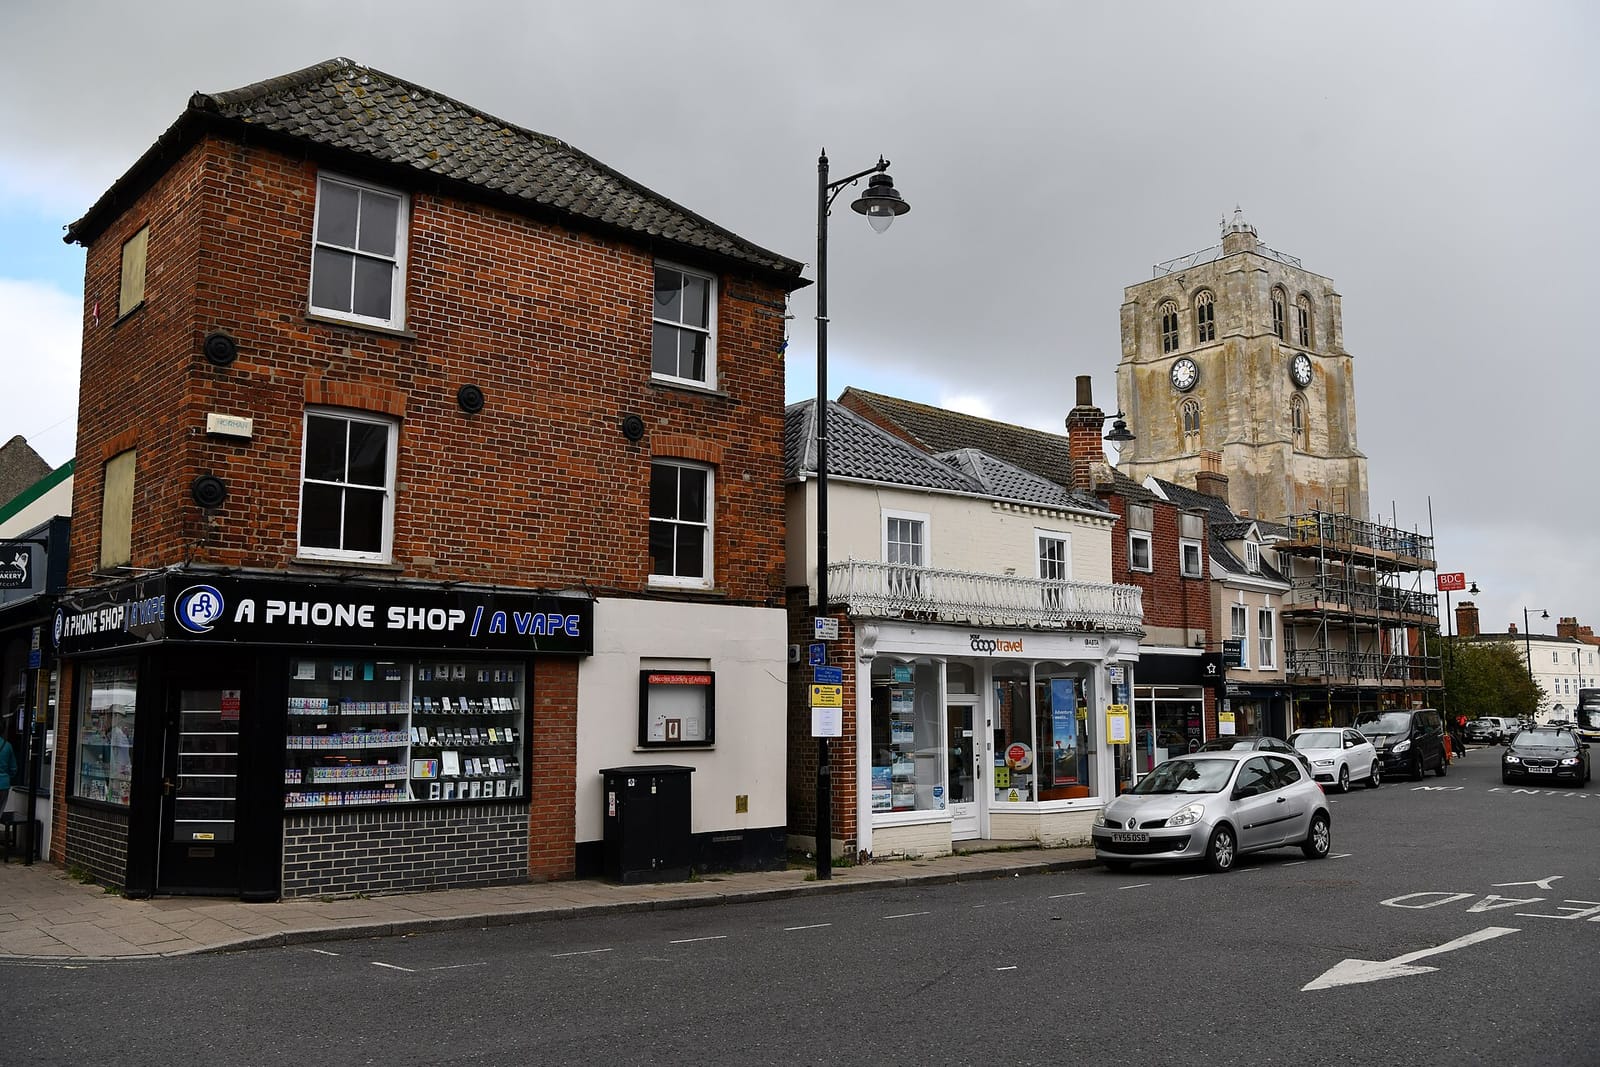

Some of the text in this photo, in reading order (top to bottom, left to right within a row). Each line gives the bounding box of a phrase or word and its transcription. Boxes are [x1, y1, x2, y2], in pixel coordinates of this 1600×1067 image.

[1440, 573, 1461, 584] BDC
[64, 616, 70, 637] A
[70, 611, 98, 636] PHONE
[100, 606, 124, 632] SHOP
[234, 599, 256, 623] A
[266, 599, 375, 628] PHONE
[387, 606, 466, 631] SHOP
[489, 610, 507, 634] A
[513, 611, 580, 637] VAPE
